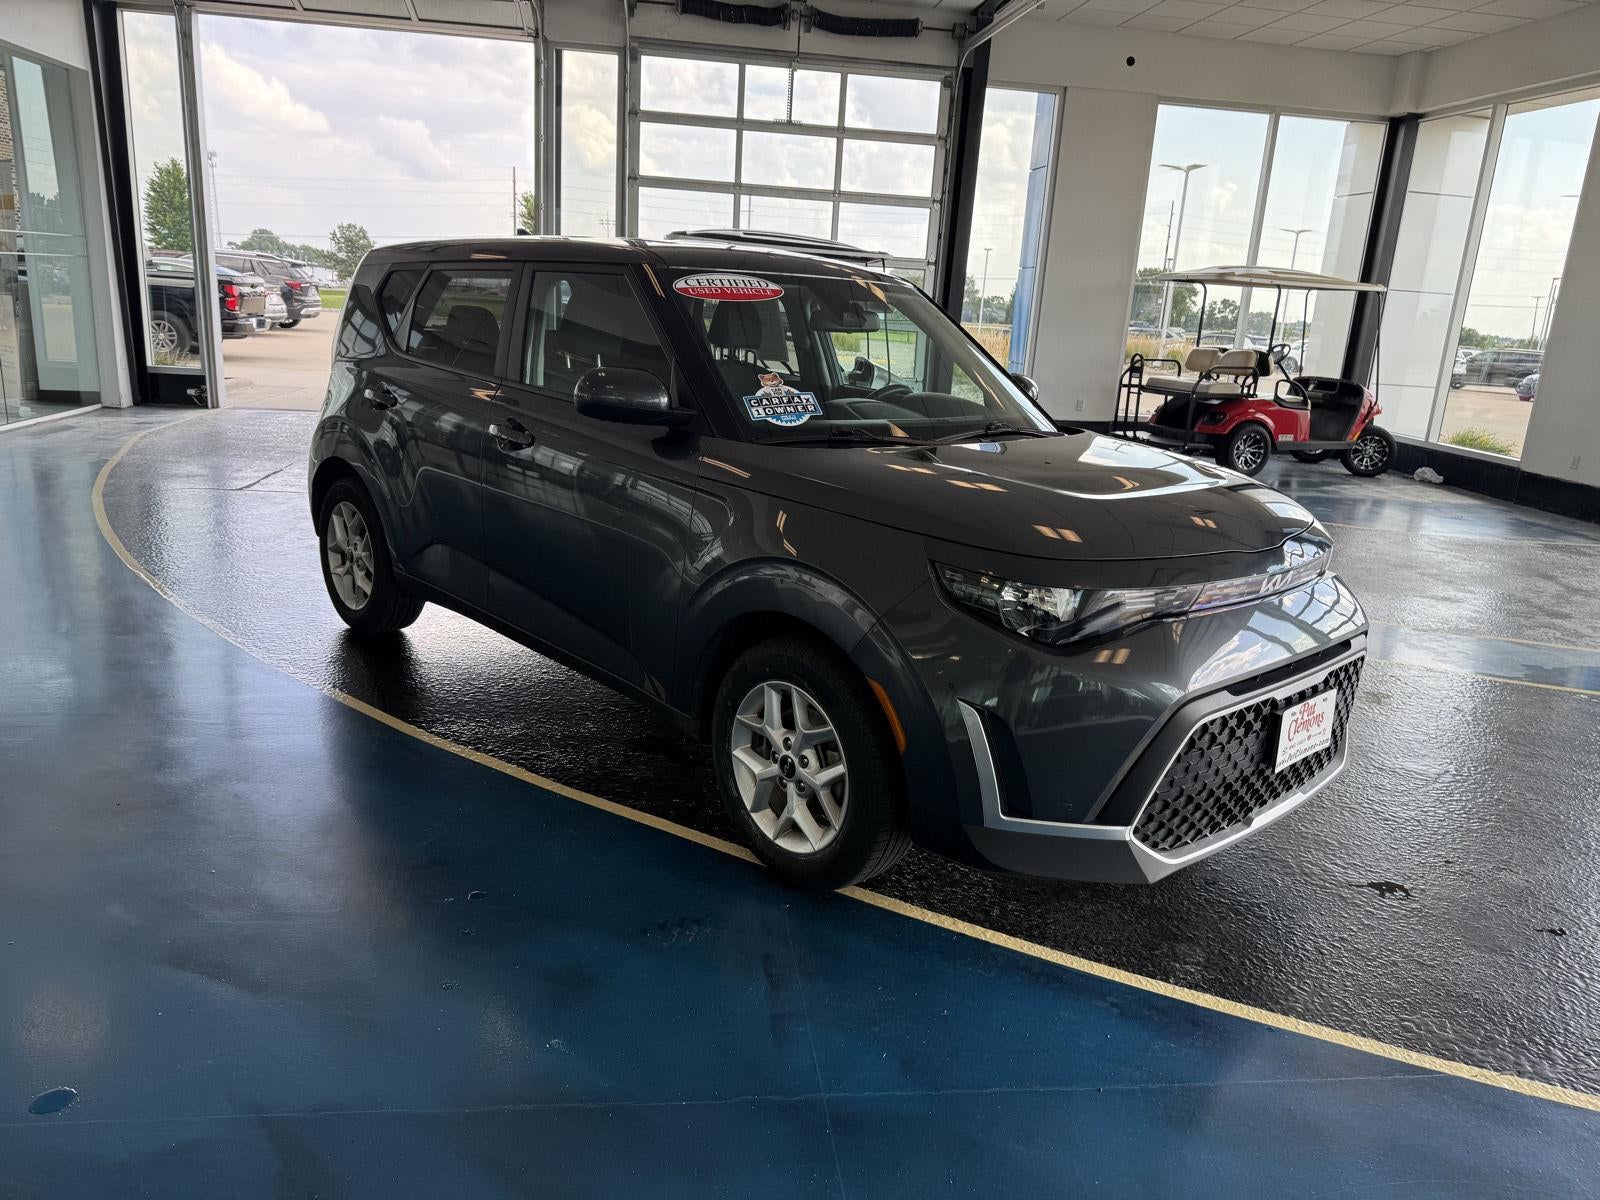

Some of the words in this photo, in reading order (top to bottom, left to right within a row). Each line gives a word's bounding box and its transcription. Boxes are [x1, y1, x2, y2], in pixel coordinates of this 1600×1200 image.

[684, 278, 769, 288] CERTIFIED
[688, 287, 721, 295] USED
[723, 287, 774, 296] VEHICLE
[750, 395, 813, 407] CARFAX
[765, 405, 816, 415] OWNER
[1299, 701, 1317, 720] Pat
[1287, 711, 1325, 742] Clemons
